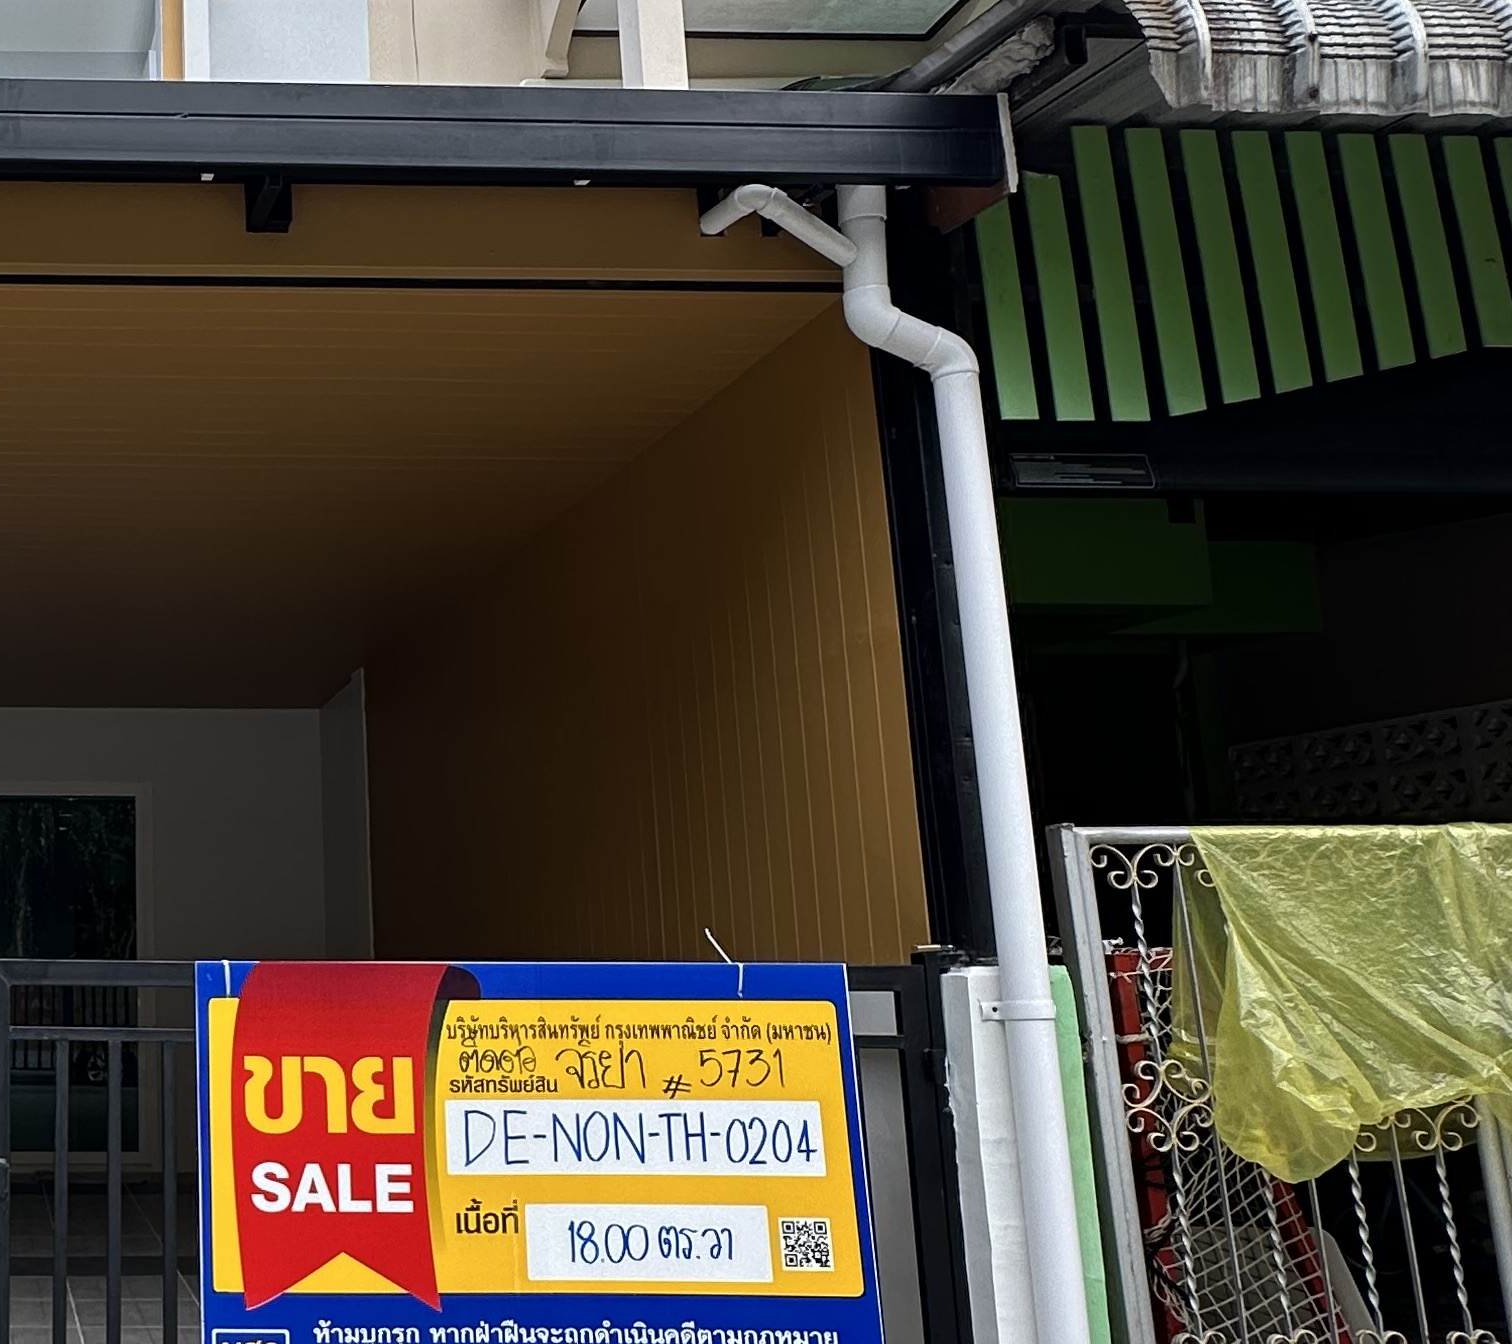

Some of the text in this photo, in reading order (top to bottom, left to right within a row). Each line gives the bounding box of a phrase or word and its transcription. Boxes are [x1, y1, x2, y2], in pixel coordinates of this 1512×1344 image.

[721, 1017, 761, 1041] จำกัด
[766, 1022, 832, 1045] (มหาชน)
[449, 1074, 558, 1094] รหัสทรัพย์สิน
[699, 1048, 785, 1088] 5731
[244, 1056, 415, 1134] ขาย
[464, 1109, 818, 1167] DE-NON-TH-0204
[251, 1162, 414, 1213] SALE
[455, 1198, 519, 1234] เนื้อที่
[568, 1220, 649, 1264] 18.00
